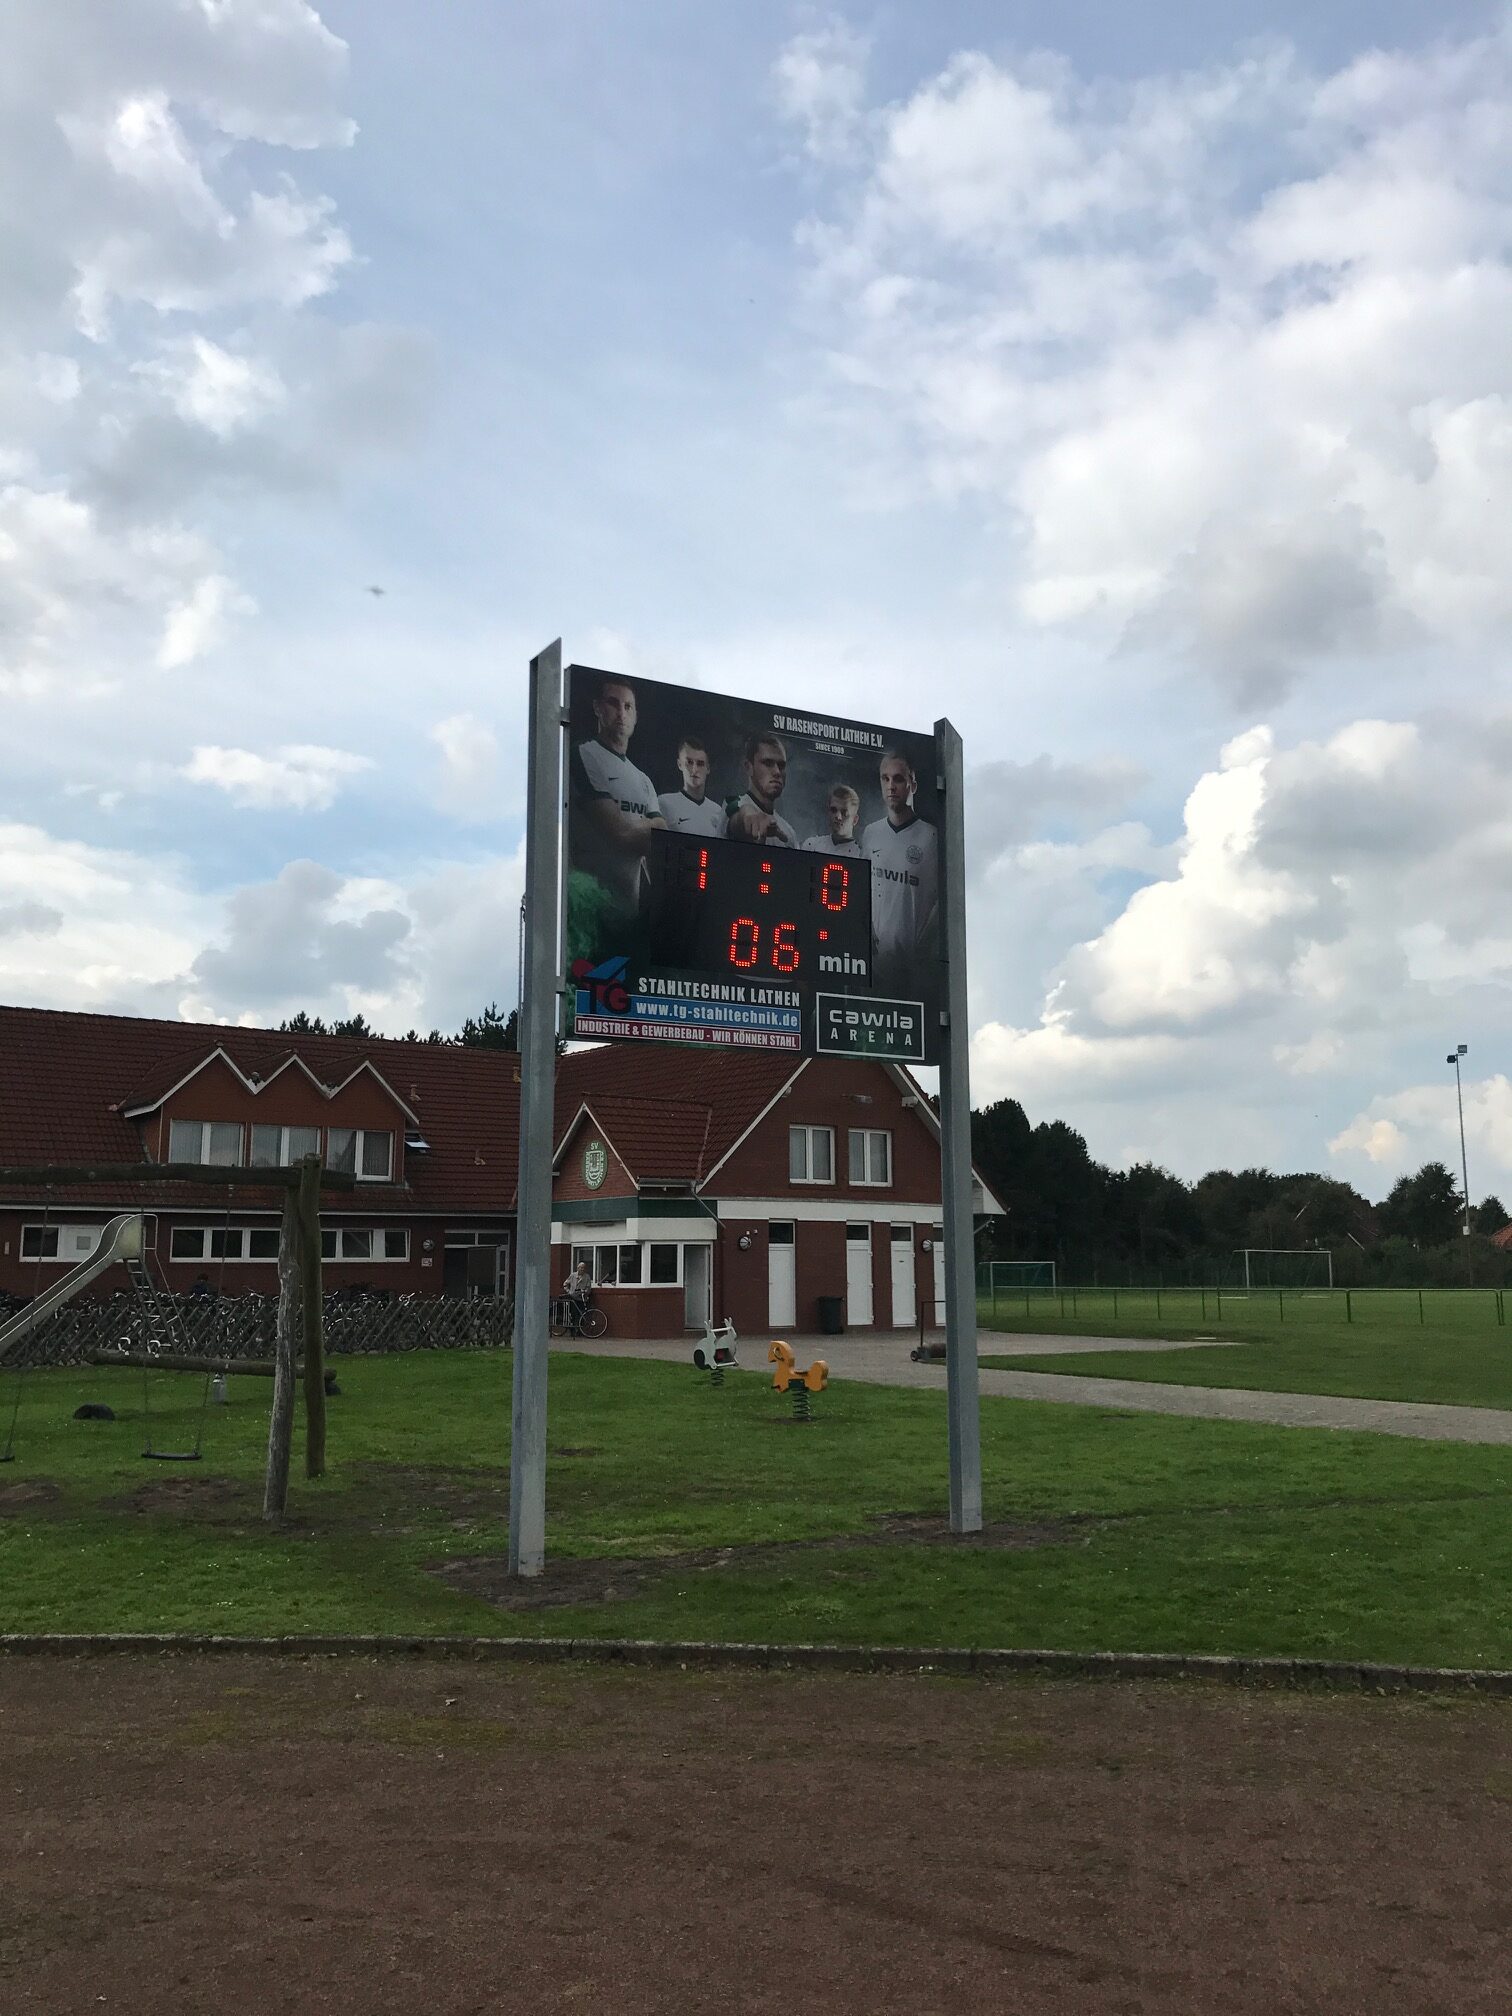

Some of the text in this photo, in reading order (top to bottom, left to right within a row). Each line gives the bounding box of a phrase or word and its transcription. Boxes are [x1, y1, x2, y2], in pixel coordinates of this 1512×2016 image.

[773, 714, 884, 748] SV RASENSPORT LATHEN E.V.
[815, 742, 831, 752] SINCE
[699, 849, 708, 890] 1
[821, 863, 849, 911] 0
[729, 917, 867, 976] 06 min
[638, 977, 800, 1007] STAHLTECHNIK LATHEN
[636, 1002, 798, 1027] www.tg-stahltechnik.de
[829, 1009, 914, 1030] cawila
[577, 1019, 630, 1035] INDUSTRIE
[632, 1025, 640, 1036] &
[641, 1025, 704, 1041] GEWERBEBAU
[712, 1029, 731, 1043] WIR
[733, 1029, 768, 1045] KÖNNEN
[769, 1034, 797, 1048] STAHL
[830, 1027, 912, 1046] ARENA
[590, 1142, 599, 1150] SV
